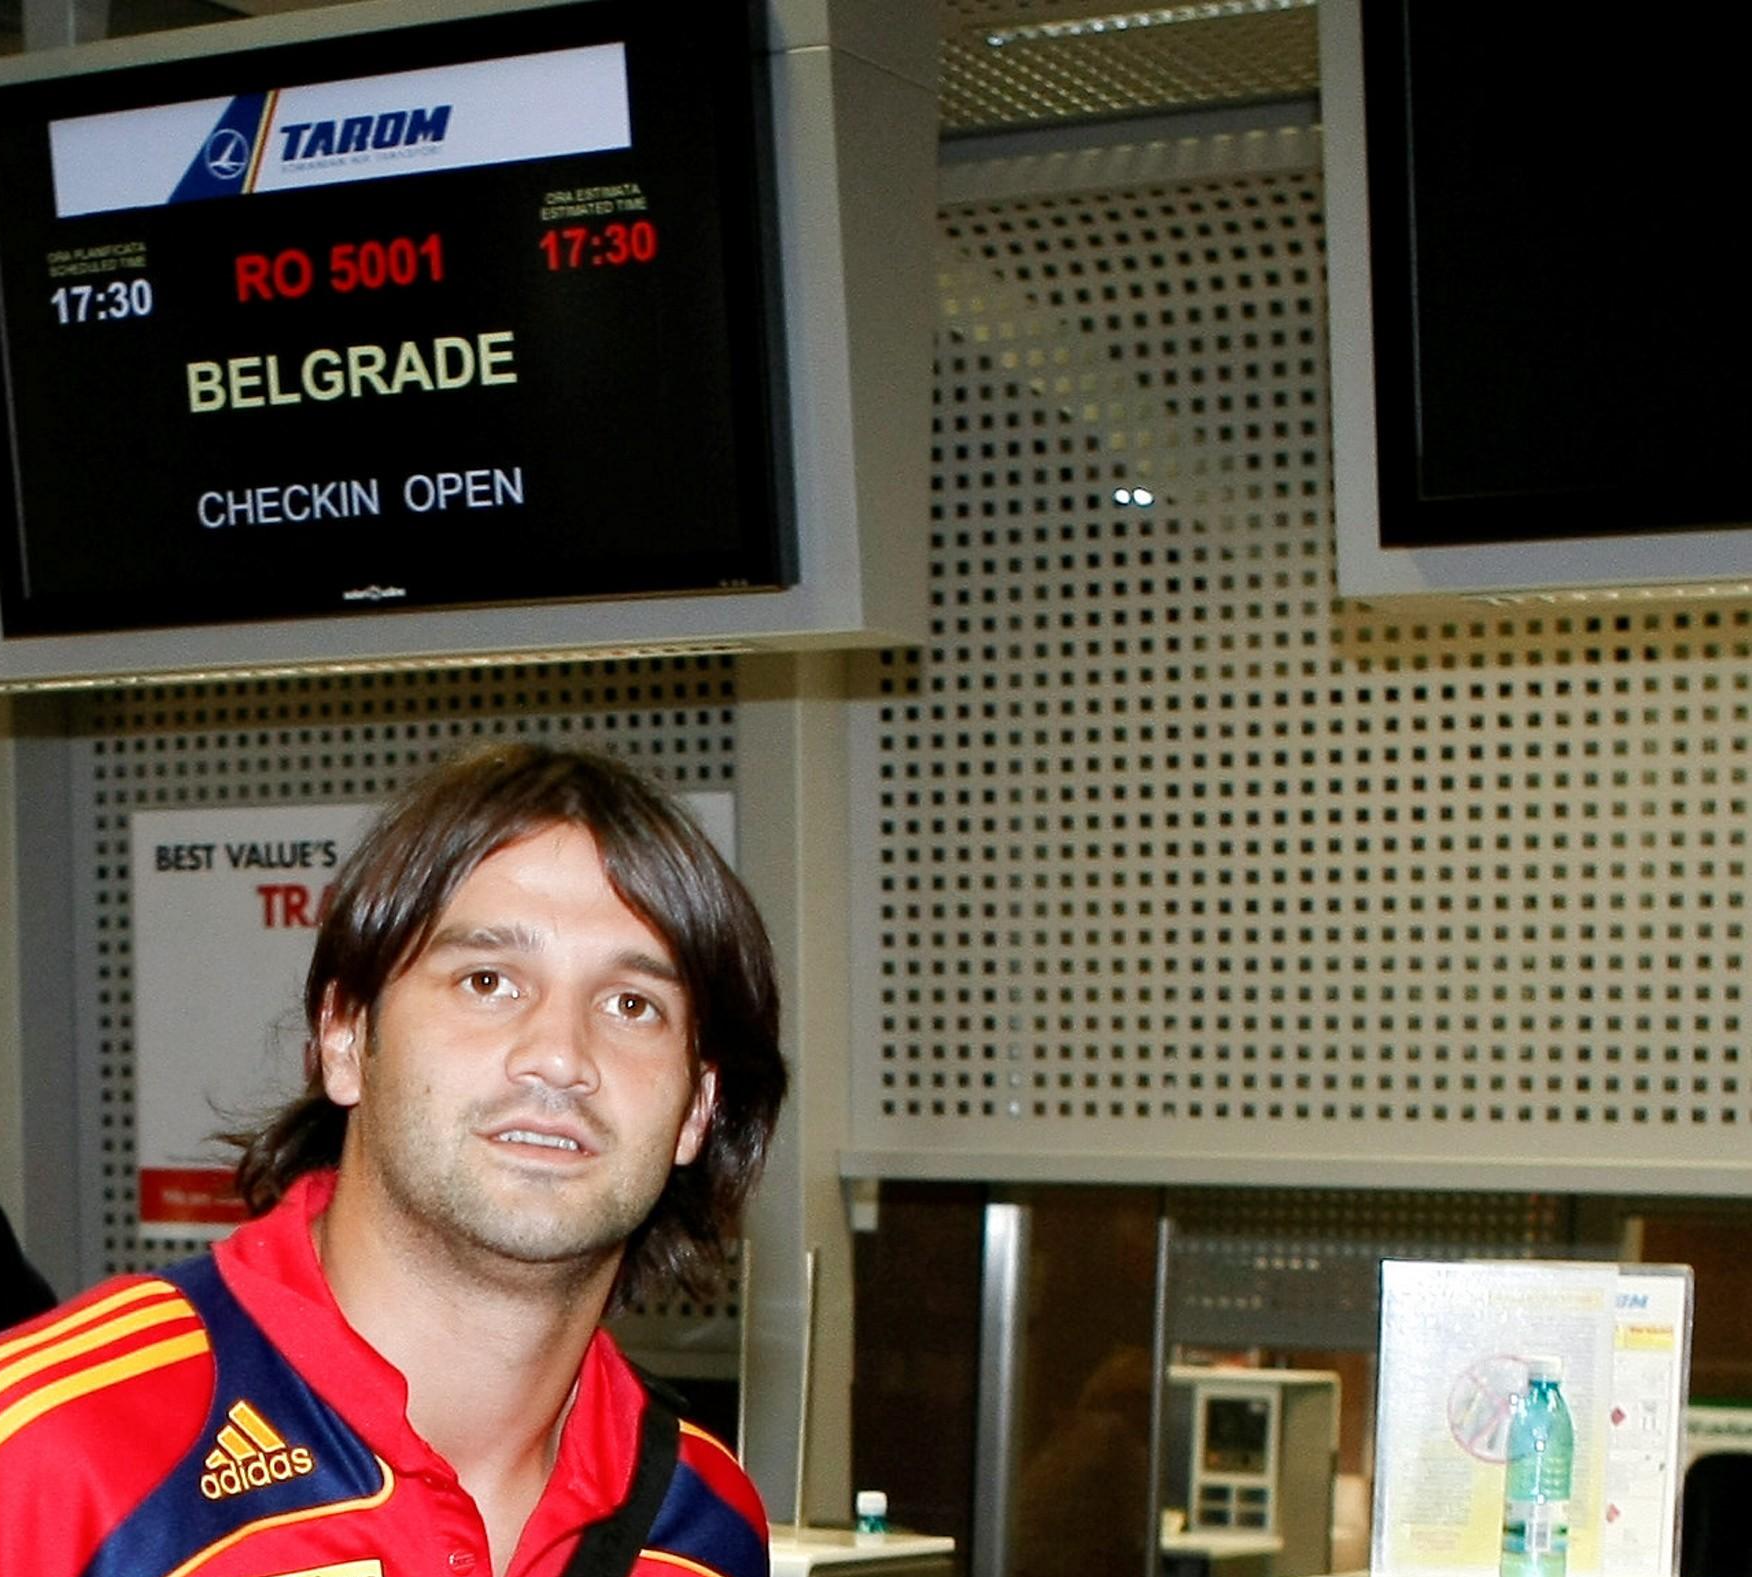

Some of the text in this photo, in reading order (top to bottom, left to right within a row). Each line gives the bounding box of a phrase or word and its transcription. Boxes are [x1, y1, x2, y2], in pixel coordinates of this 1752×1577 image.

[280, 105, 453, 161] TAROM
[235, 234, 445, 304] RO 5001
[538, 222, 657, 271] 17:30
[50, 279, 153, 324] 17:30
[186, 331, 518, 413] BELGRADE
[197, 467, 526, 529] CHECKIN OPEN
[155, 839, 338, 871] BEST VALUE'S
[200, 1446, 316, 1501] adidas
